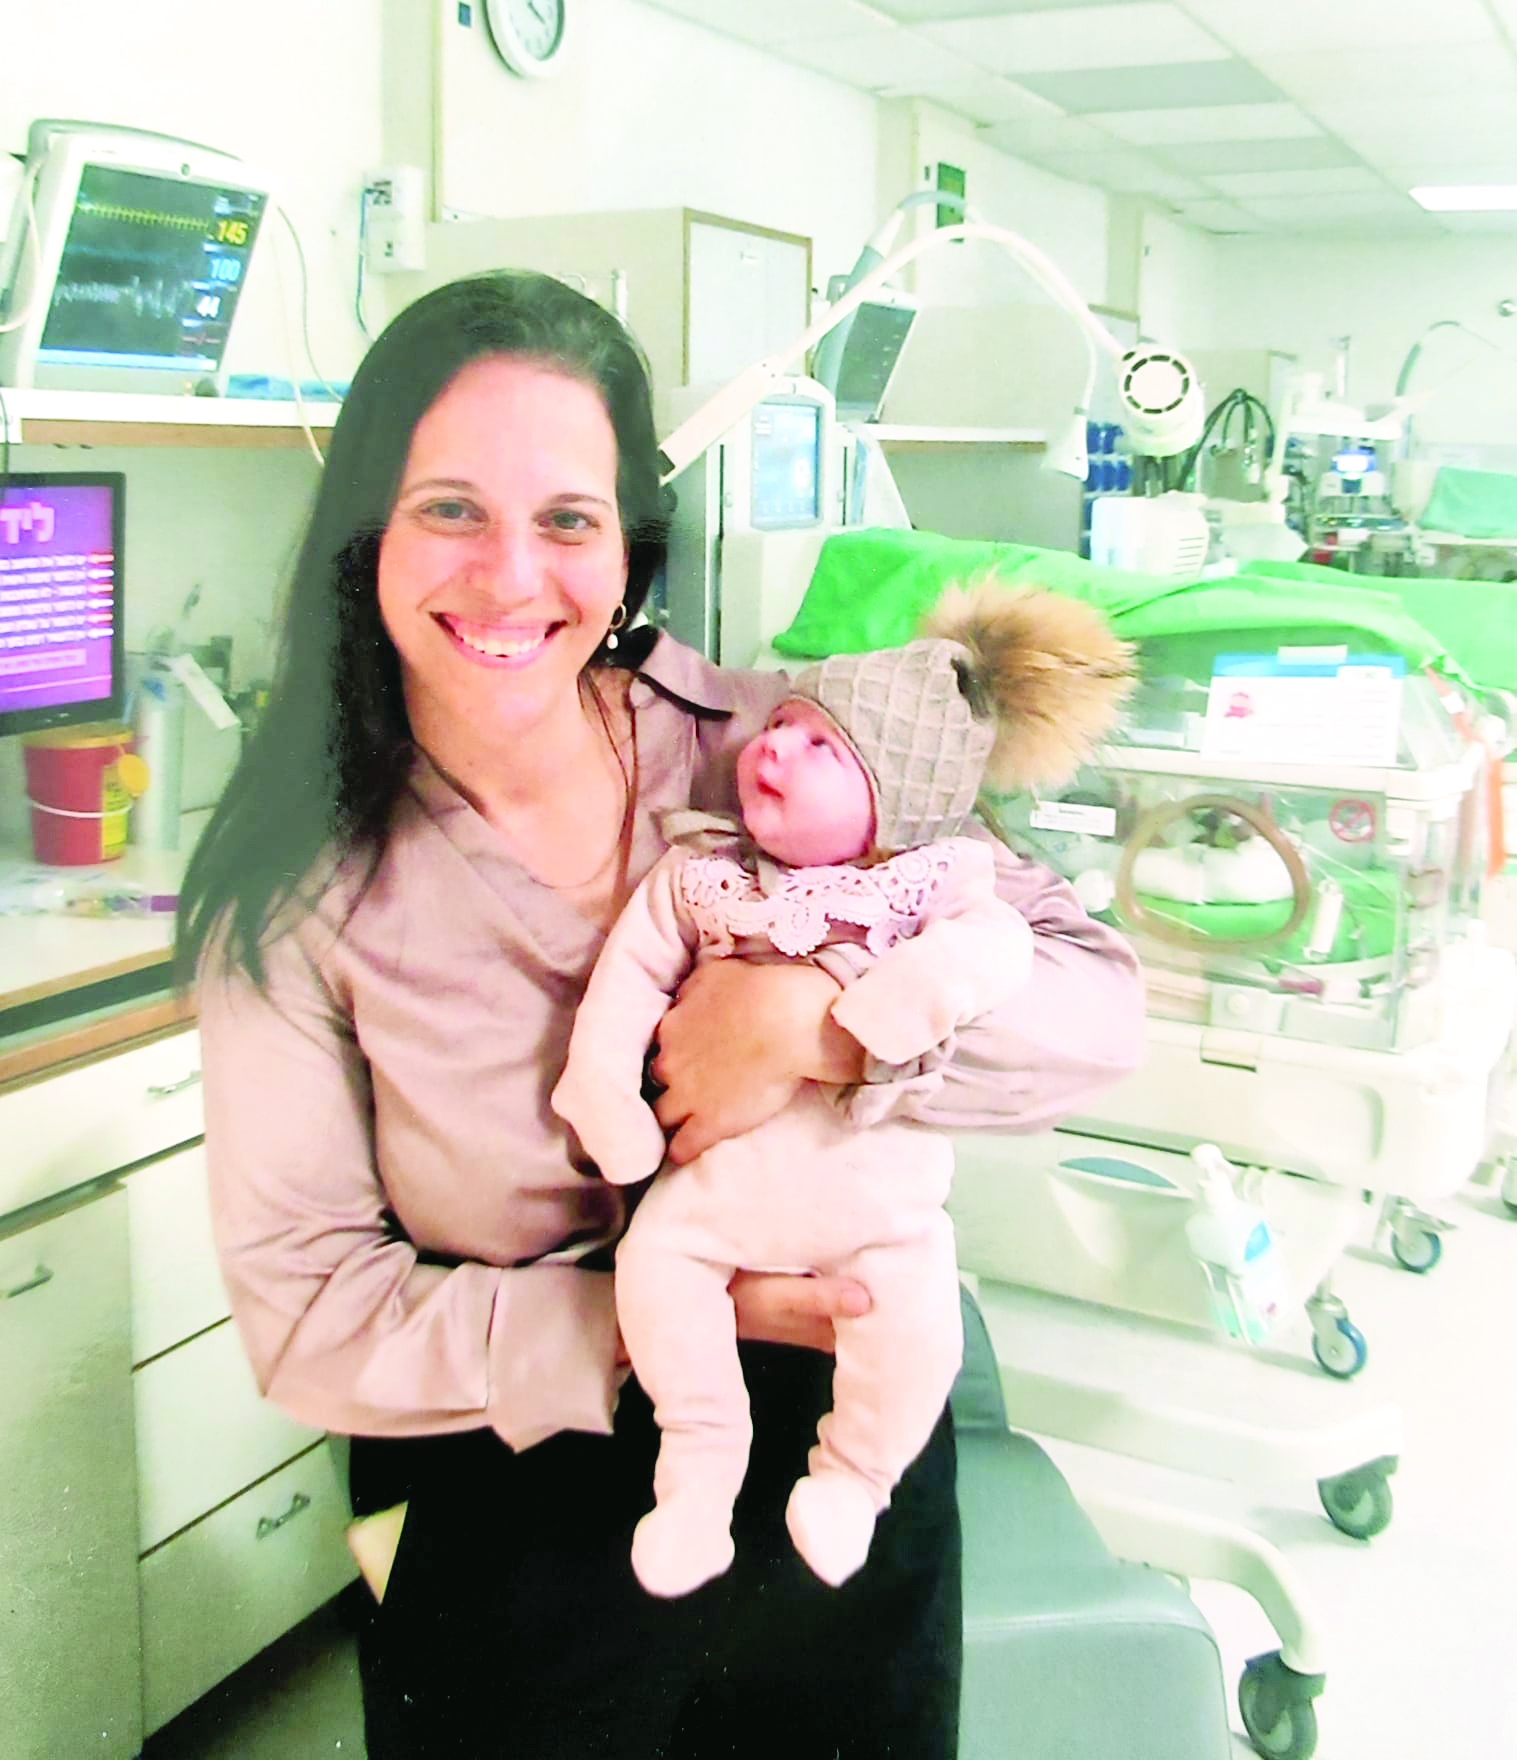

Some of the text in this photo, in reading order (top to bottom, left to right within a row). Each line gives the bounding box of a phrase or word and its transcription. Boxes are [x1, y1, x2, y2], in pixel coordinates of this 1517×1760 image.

[218, 220, 249, 245] 145
[211, 258, 241, 281] 100
[196, 295, 221, 318] 44
